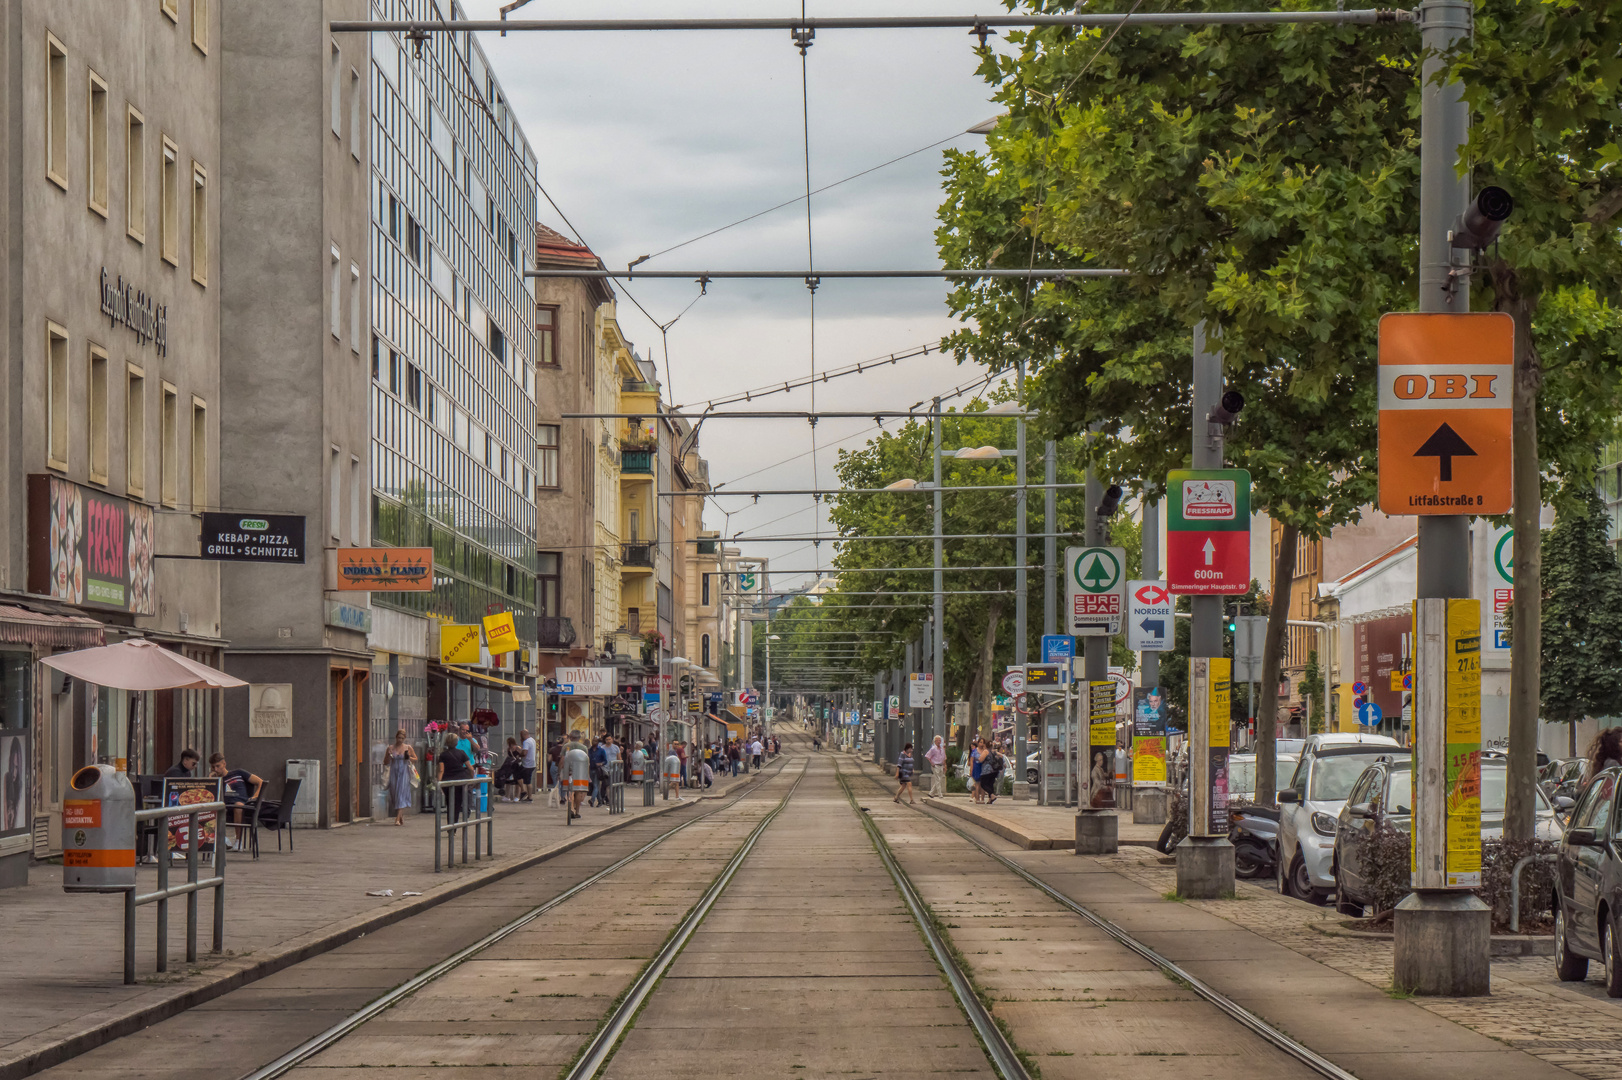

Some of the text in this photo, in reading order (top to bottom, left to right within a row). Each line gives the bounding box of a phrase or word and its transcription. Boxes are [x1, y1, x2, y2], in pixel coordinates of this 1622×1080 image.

[1393, 374, 1498, 400] OBI
[1408, 494, 1483, 506] Litfaßstraße 8
[242, 521, 266, 529] FRESH
[87, 499, 124, 578] FRESH
[218, 533, 289, 545] KEBAP PIZZA
[207, 545, 299, 557] GRILL SCHNITZEL
[343, 566, 382, 575] INDRA'S
[390, 566, 427, 575] PLANET
[1194, 569, 1224, 580] 600m
[1075, 595, 1119, 604] EURO
[1075, 604, 1119, 613] SPAR
[490, 625, 510, 638] BILLA
[74, 808, 84, 816] UND
